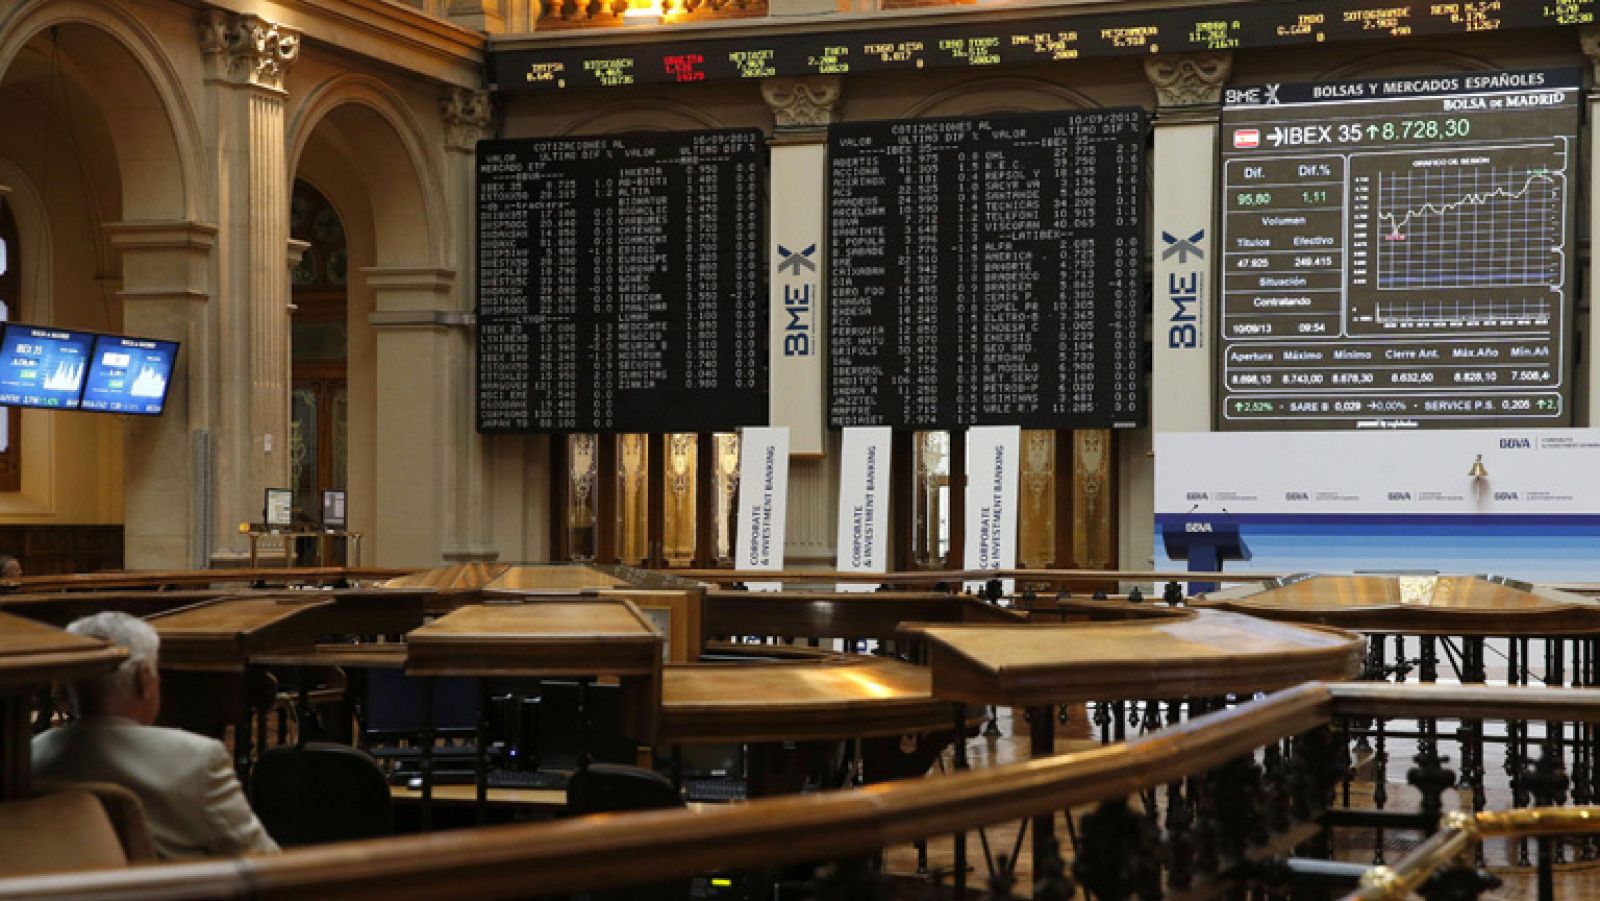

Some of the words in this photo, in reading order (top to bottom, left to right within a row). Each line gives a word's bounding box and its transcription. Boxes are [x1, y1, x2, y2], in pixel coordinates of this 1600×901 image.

[1313, 84, 1363, 99] BOLSAS
[1369, 84, 1378, 95] Y
[1383, 79, 1458, 94] MERCADOS
[1465, 73, 1545, 90] ESPAÑOLES
[1225, 90, 1261, 104] BME
[1444, 98, 1485, 111] BOLSA
[1505, 91, 1565, 107] MADRID
[1282, 126, 1331, 144] IBEX
[1338, 124, 1363, 142] 35
[1383, 118, 1470, 141] 8.728,30
[1244, 166, 1265, 178] Dif.
[1298, 164, 1331, 177] Dif.%
[1262, 216, 1307, 226] Volumen
[1294, 236, 1334, 246] Efectivo
[1169, 271, 1197, 348] BME
[1253, 297, 1311, 307] Contratando
[784, 283, 809, 356] BME
[1231, 351, 1274, 362] Apertura
[1385, 349, 1415, 360] Cierre
[1419, 348, 1440, 359] Ant.
[1424, 400, 1472, 411] SERVICE
[1499, 438, 1531, 449] BBVA
[764, 445, 776, 490] BANKING
[866, 445, 876, 490] BANKING
[994, 445, 1004, 492] BANKING
[750, 505, 761, 566] CORPORATE
[762, 493, 772, 558] INVESTMENT
[864, 494, 874, 558] INVESTMENT
[992, 494, 1002, 560] INVESTMENT
[1185, 522, 1213, 533] BBVA
[852, 505, 863, 568] CORPORATE
[979, 506, 990, 569] CORPORATE
[761, 558, 769, 566] &
[864, 558, 872, 568] &
